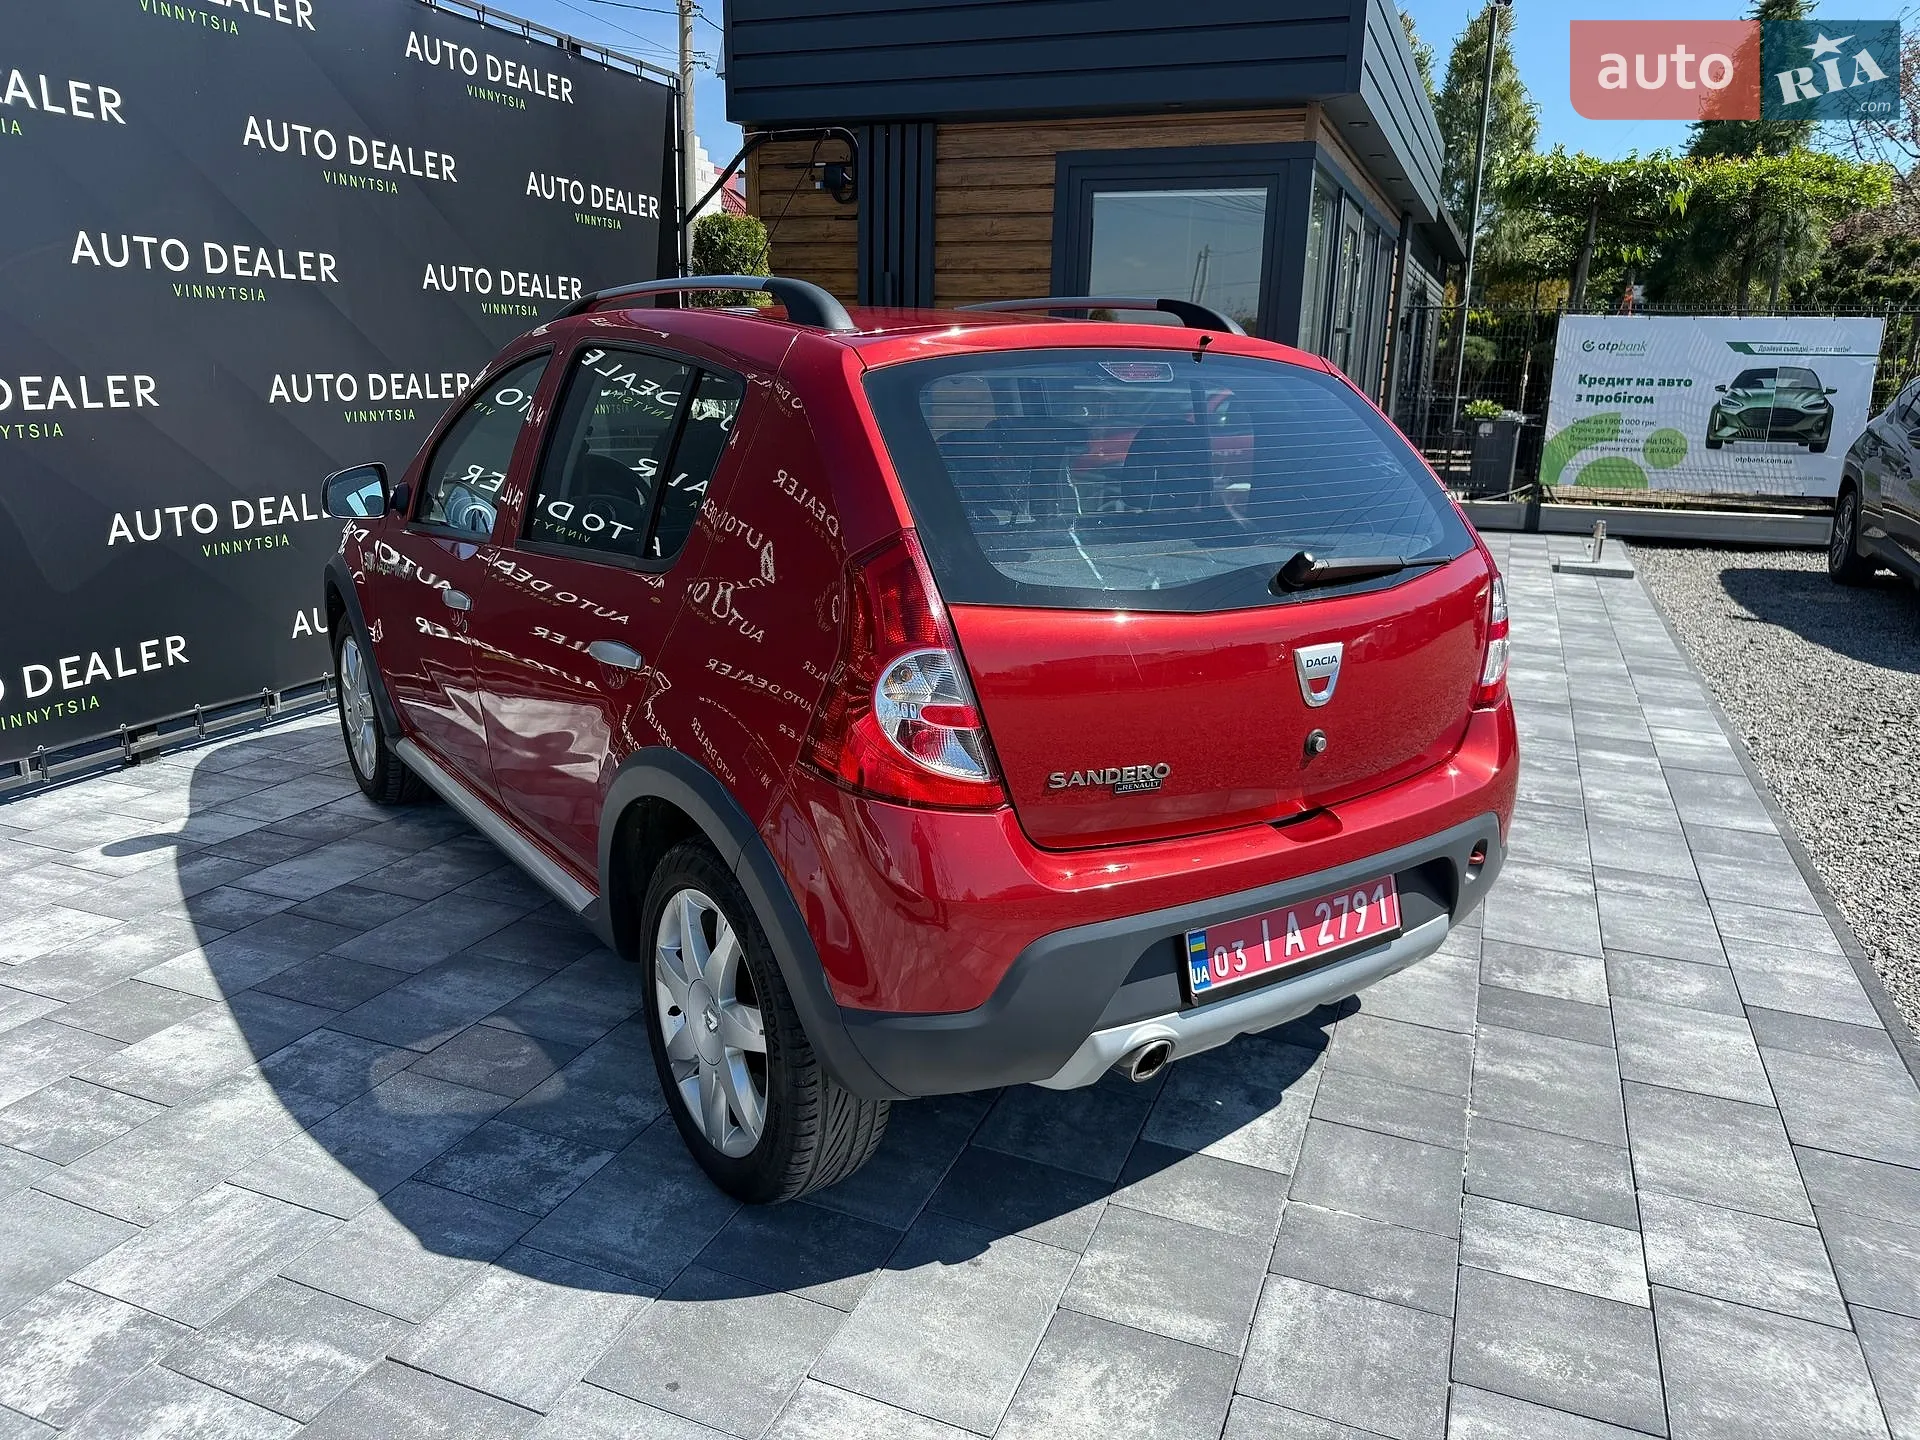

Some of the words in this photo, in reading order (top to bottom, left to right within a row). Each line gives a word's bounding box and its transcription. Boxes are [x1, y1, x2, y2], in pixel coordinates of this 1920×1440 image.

[139, 0, 239, 35] VINNYTSIA
[405, 31, 478, 76] AUTO
[486, 54, 574, 104] DEALER
[0, 69, 126, 125] ALER
[466, 84, 526, 110] VINNYTSIA
[243, 116, 337, 160] AUTO
[348, 135, 457, 182] DEALER
[323, 170, 398, 194] VINNYTSIA
[526, 171, 584, 205] AUTO
[590, 184, 659, 219] DEALER
[575, 212, 621, 230] VINNYTSIA
[71, 230, 189, 272] AUTO
[203, 241, 339, 283] DEALER
[173, 283, 265, 301] VINNYTSIA
[422, 263, 492, 295] AUTO
[499, 270, 583, 300] DEALER
[481, 302, 538, 316] VINNYTSIA
[1598, 340, 1647, 353] otpbank
[269, 373, 358, 404] AUTO
[368, 373, 470, 401] DEALER
[1578, 374, 1633, 388] Кредит
[1636, 378, 1656, 386] на
[1658, 379, 1693, 387] авто
[1575, 394, 1582, 402] з
[1586, 392, 1655, 405] пробігом
[345, 408, 416, 423] VINNYTSIA
[0, 422, 63, 440] YTSIA
[108, 503, 218, 546] AUTO
[231, 493, 331, 530] DEAL
[203, 533, 290, 557] VINNYTSIA
[292, 608, 328, 639] AU
[22, 635, 189, 698] DEALER
[1305, 655, 1338, 668] DACIA
[0, 695, 100, 730] INNYTSIA
[1048, 762, 1171, 788] SANDERO
[1122, 781, 1160, 790] RENAULT
[1213, 940, 1247, 978] 03
[1261, 911, 1306, 962] IA
[1315, 883, 1388, 946] 2791
[1192, 967, 1210, 985] UA
